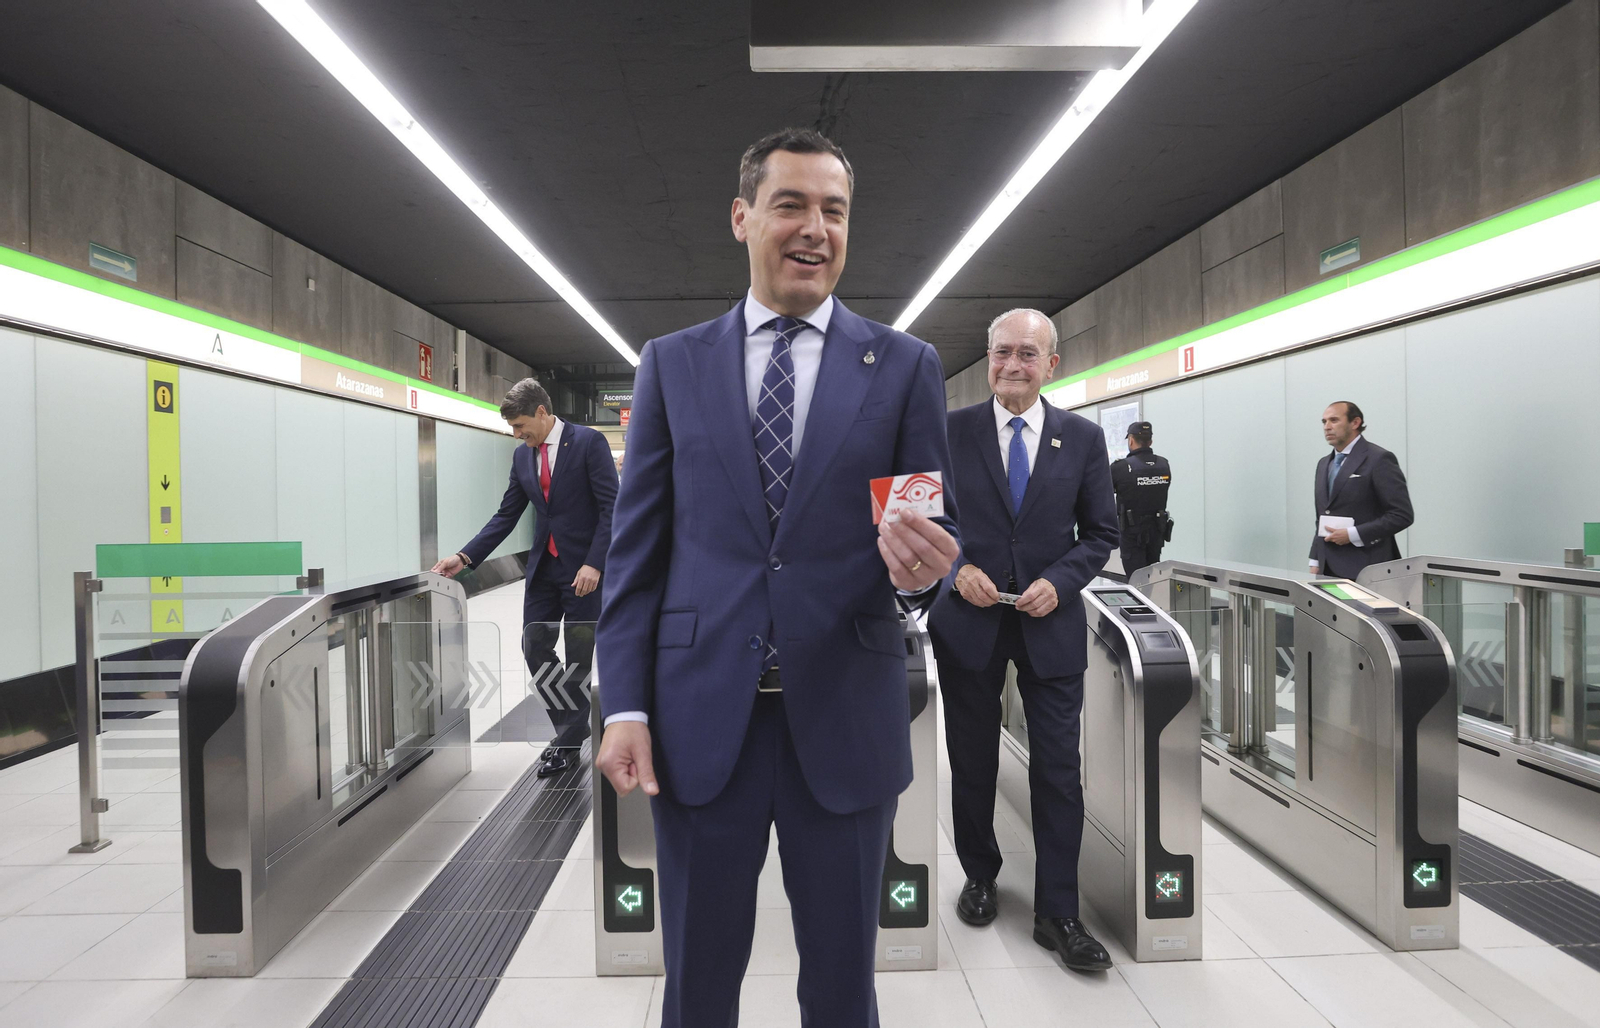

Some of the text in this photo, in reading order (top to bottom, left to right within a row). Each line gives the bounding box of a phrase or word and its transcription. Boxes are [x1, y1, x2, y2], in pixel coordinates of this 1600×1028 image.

[1186, 349, 1193, 370] 1
[335, 371, 384, 399] Atarazanas
[1106, 369, 1149, 392] Atarazanas
[411, 391, 417, 408] 1
